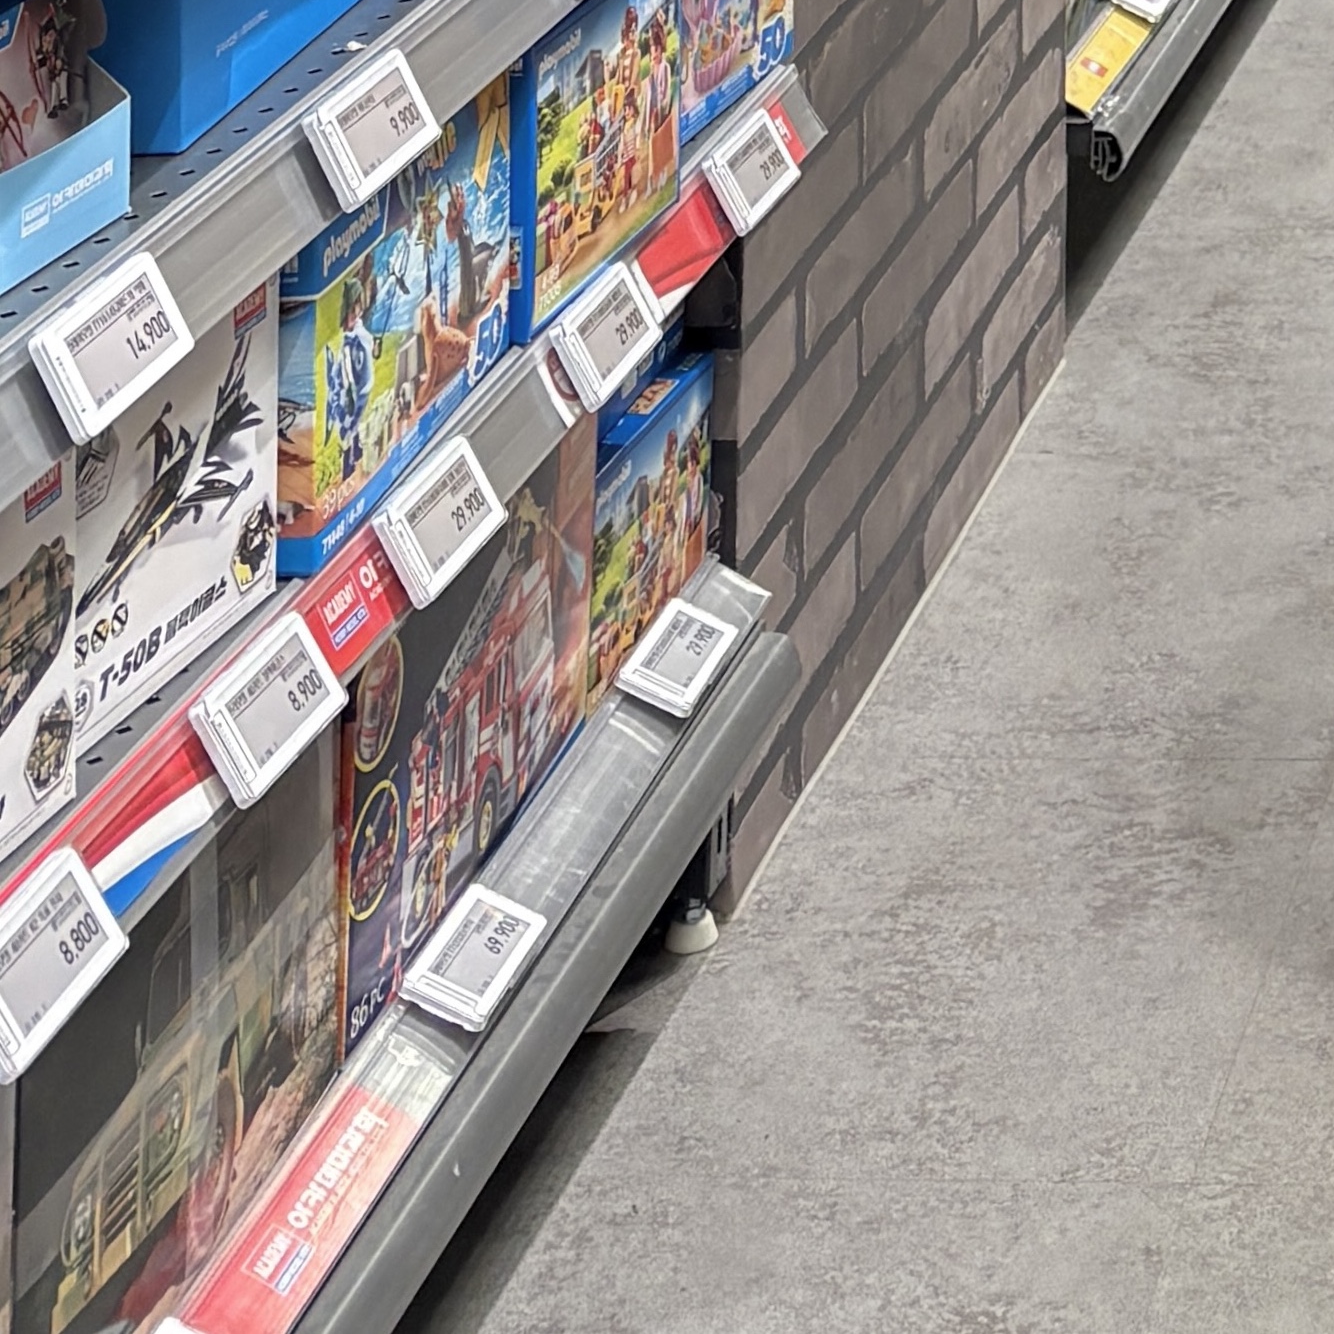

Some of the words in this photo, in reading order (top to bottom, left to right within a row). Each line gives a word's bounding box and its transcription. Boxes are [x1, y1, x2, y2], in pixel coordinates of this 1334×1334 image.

[757, 17, 786, 78] 50
[323, 193, 380, 277] playmobil
[323, 580, 356, 625] ACADEMY
[100, 626, 163, 703] T-50B
